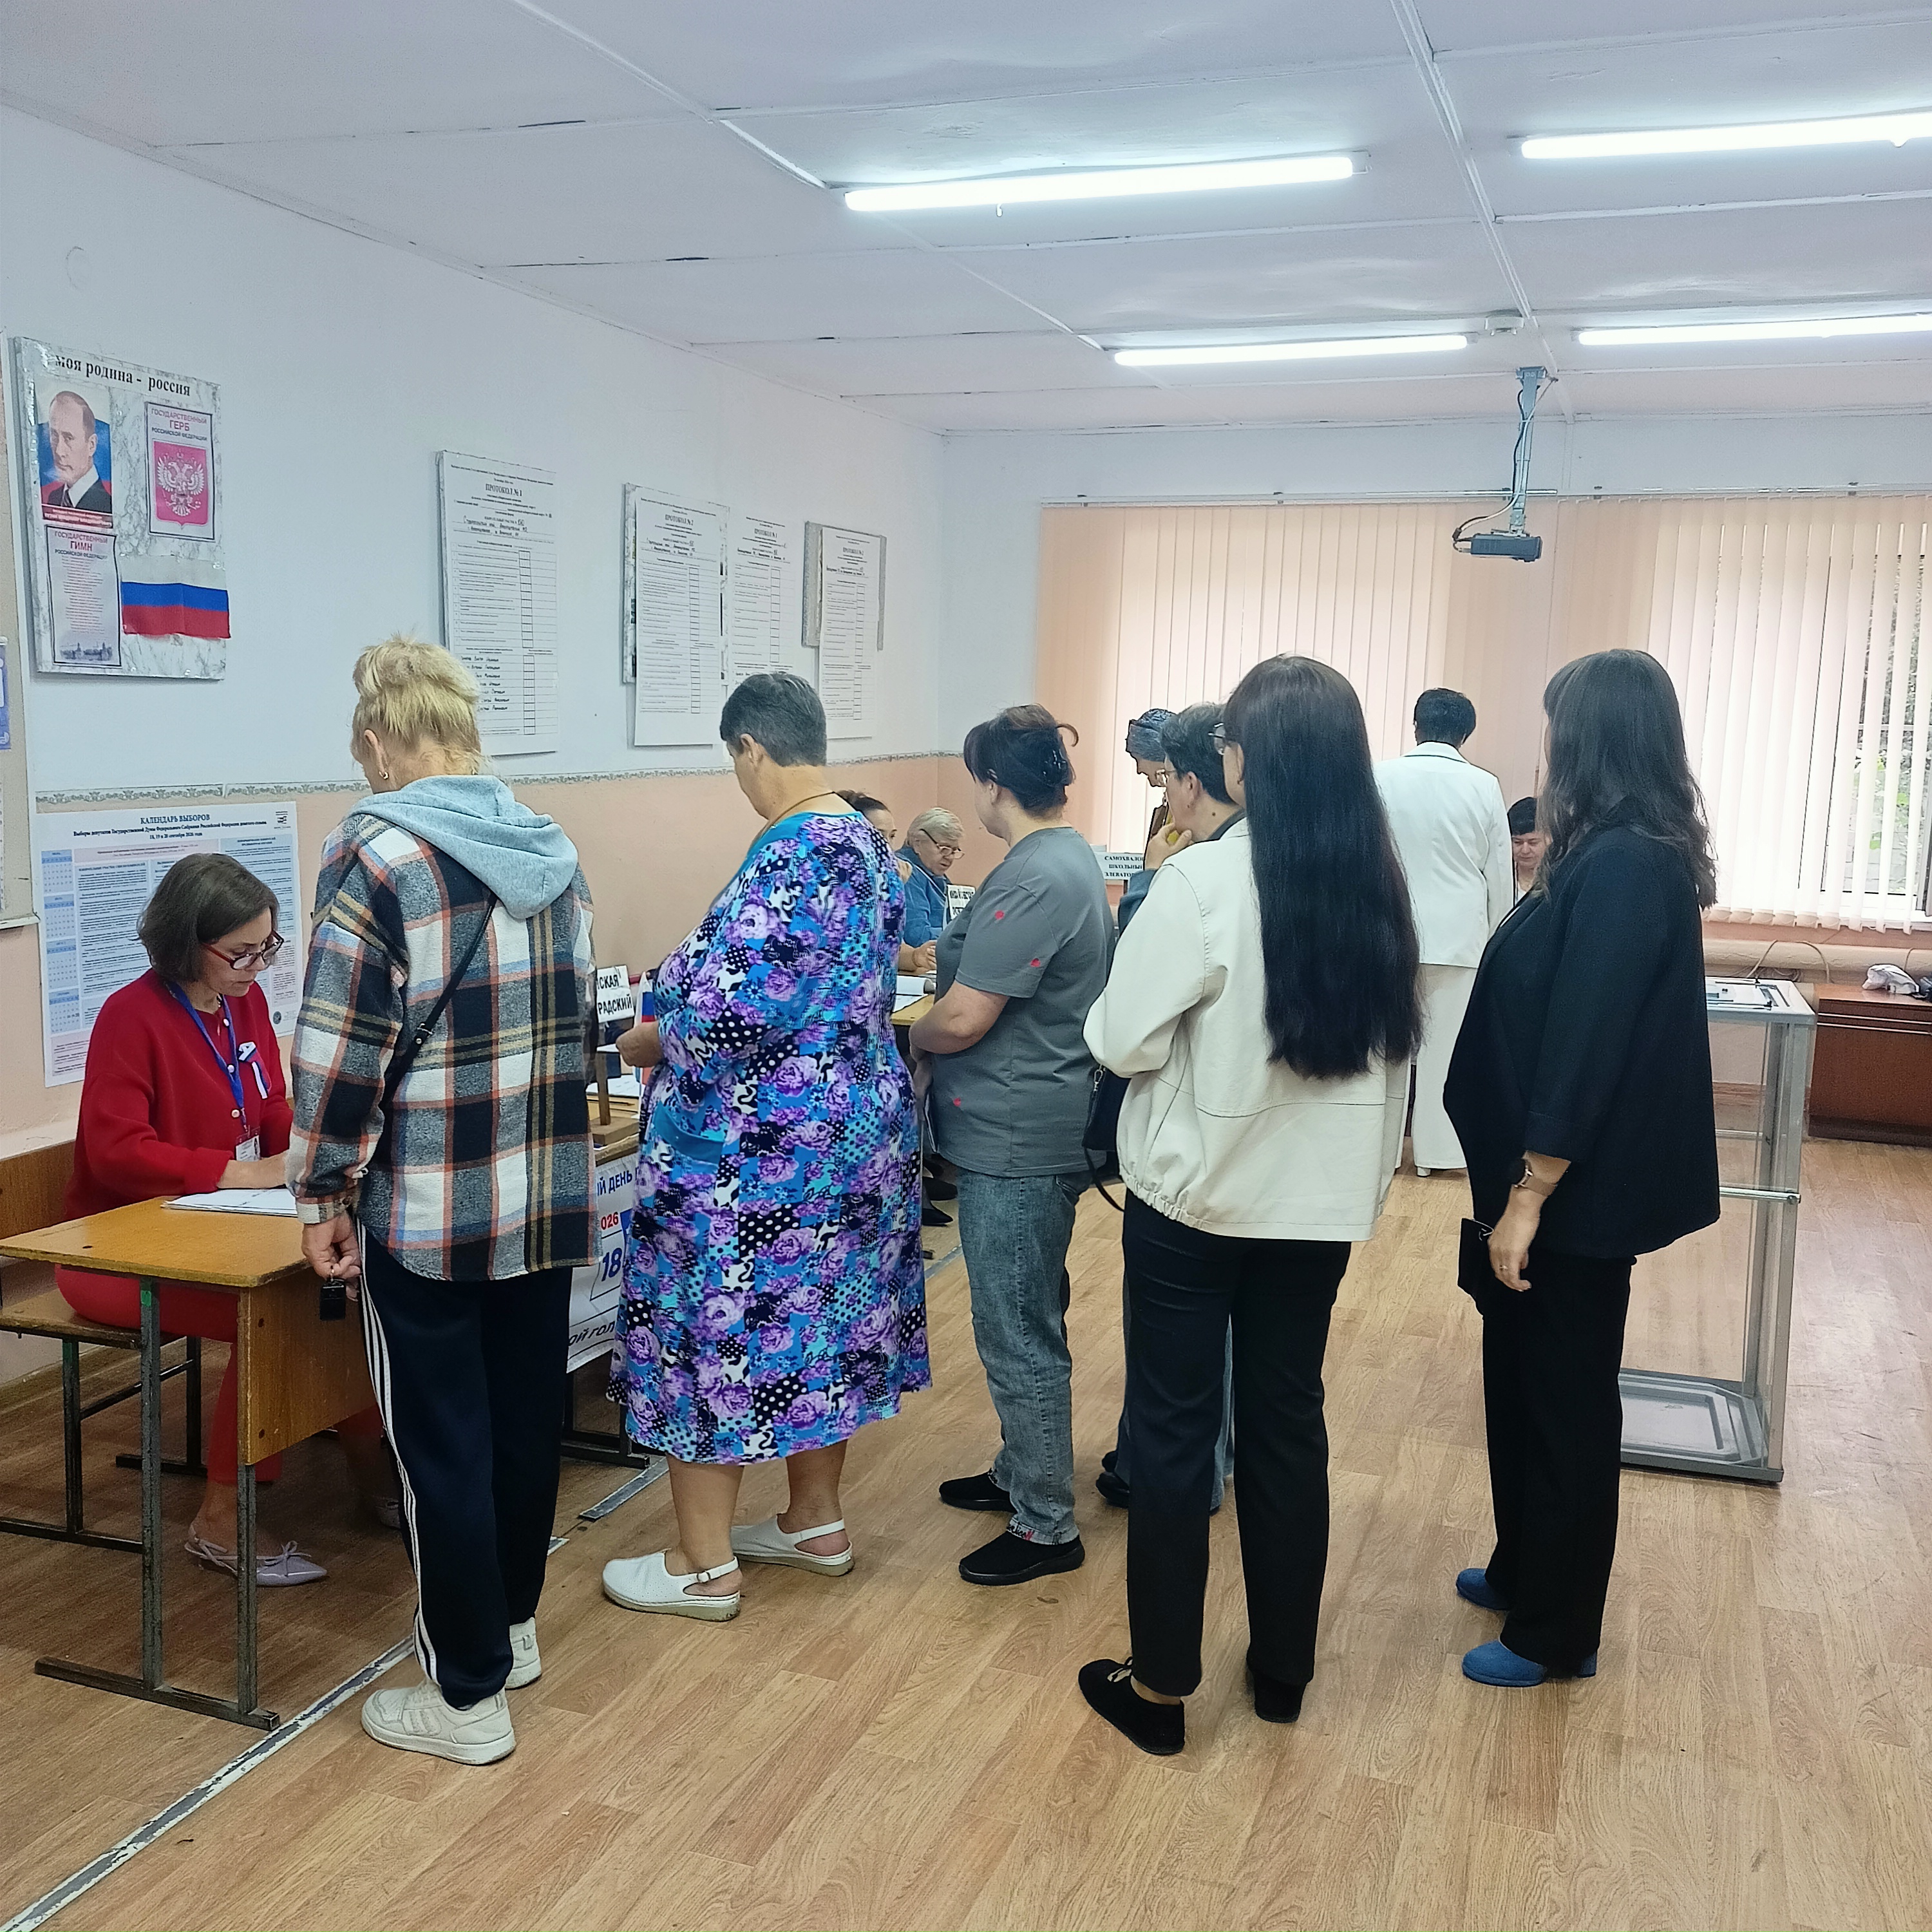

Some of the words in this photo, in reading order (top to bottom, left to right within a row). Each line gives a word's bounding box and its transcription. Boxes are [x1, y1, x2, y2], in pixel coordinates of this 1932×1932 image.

[86, 362, 133, 384] родина
[148, 376, 191, 397] россия
[151, 408, 207, 424] ГОСУДАРСТВЕННЫЙ
[169, 420, 190, 431] ГЕРБ
[486, 483, 513, 495] ПРОТОКОЛ
[54, 531, 108, 544] ГОСУДАРСТВЕННЫЙ
[70, 541, 93, 551] ГИМН
[598, 994, 632, 1015] РАДСКИЙ
[609, 1170, 633, 1194] ДЕНЬ
[601, 1211, 619, 1230] 026
[601, 1247, 623, 1282] 18
